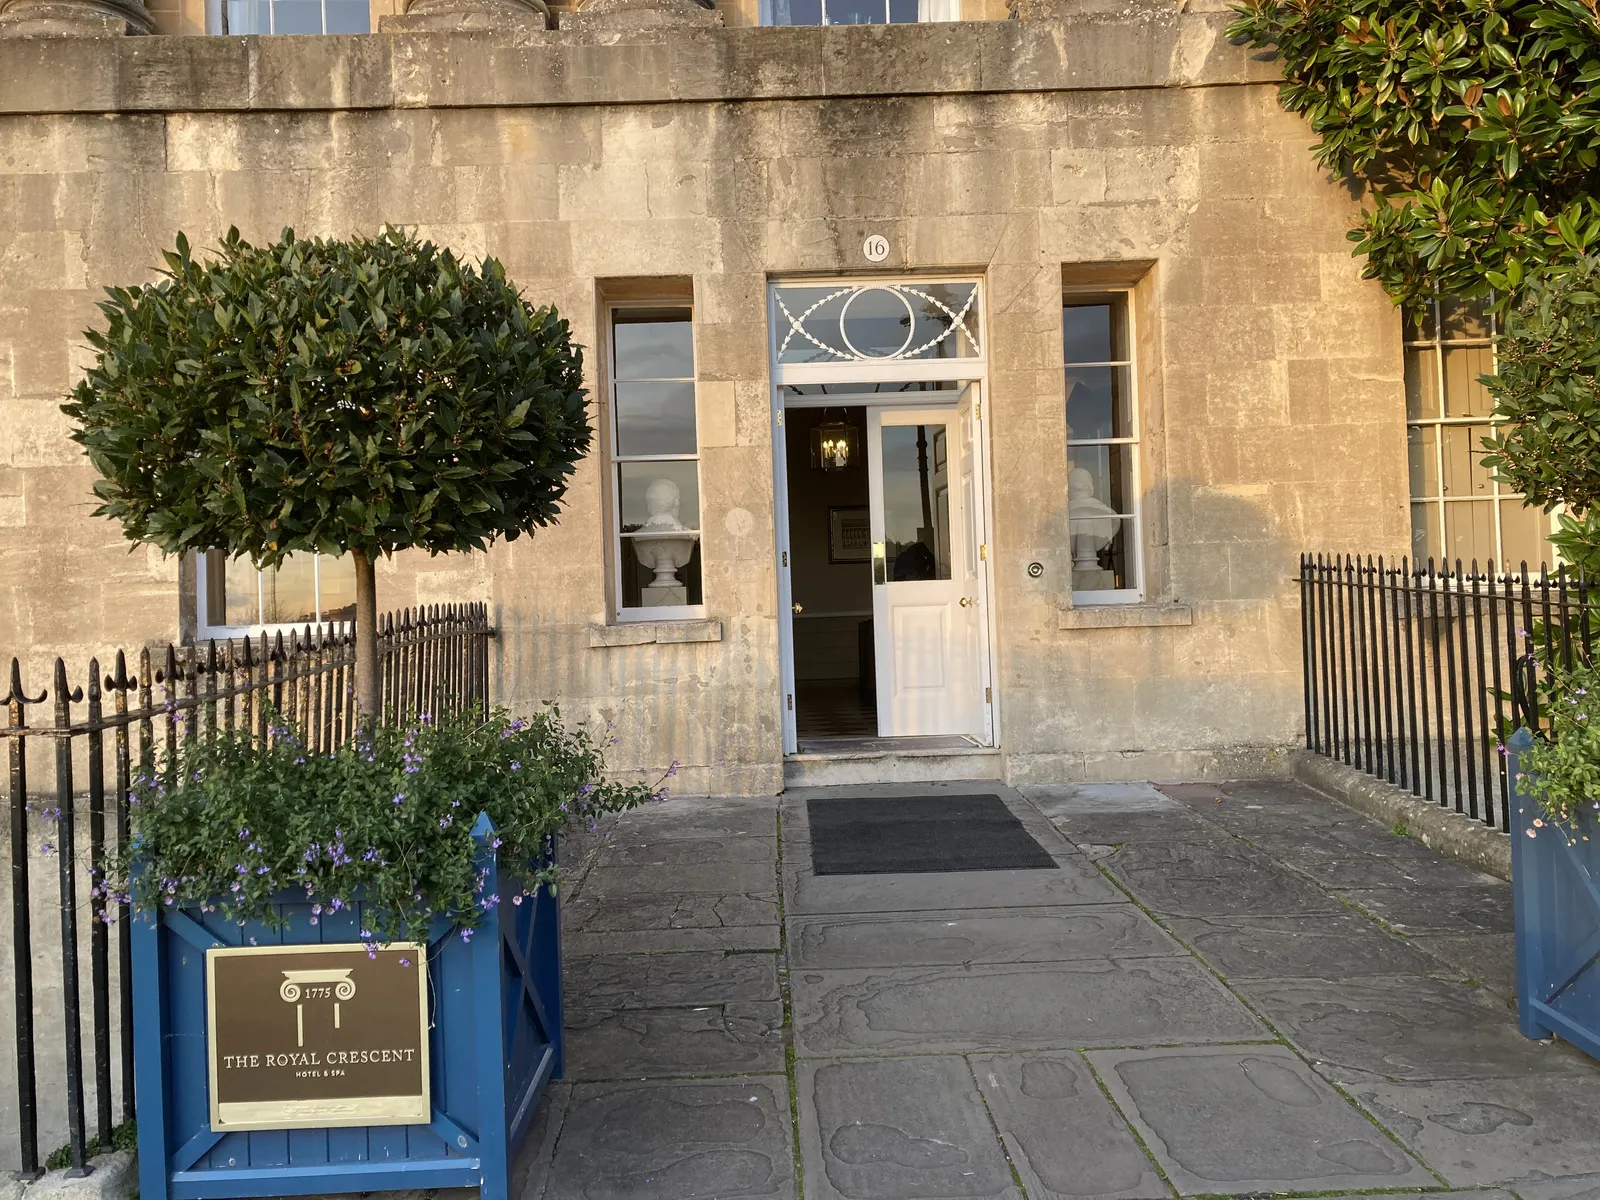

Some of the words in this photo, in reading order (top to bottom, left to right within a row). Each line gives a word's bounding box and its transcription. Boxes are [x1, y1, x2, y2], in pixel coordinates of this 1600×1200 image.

[868, 240, 885, 255] 16
[305, 988, 331, 999] 1775
[223, 1054, 260, 1069] THE
[265, 1052, 321, 1067] ROYAL
[326, 1049, 415, 1064] CRESCENT
